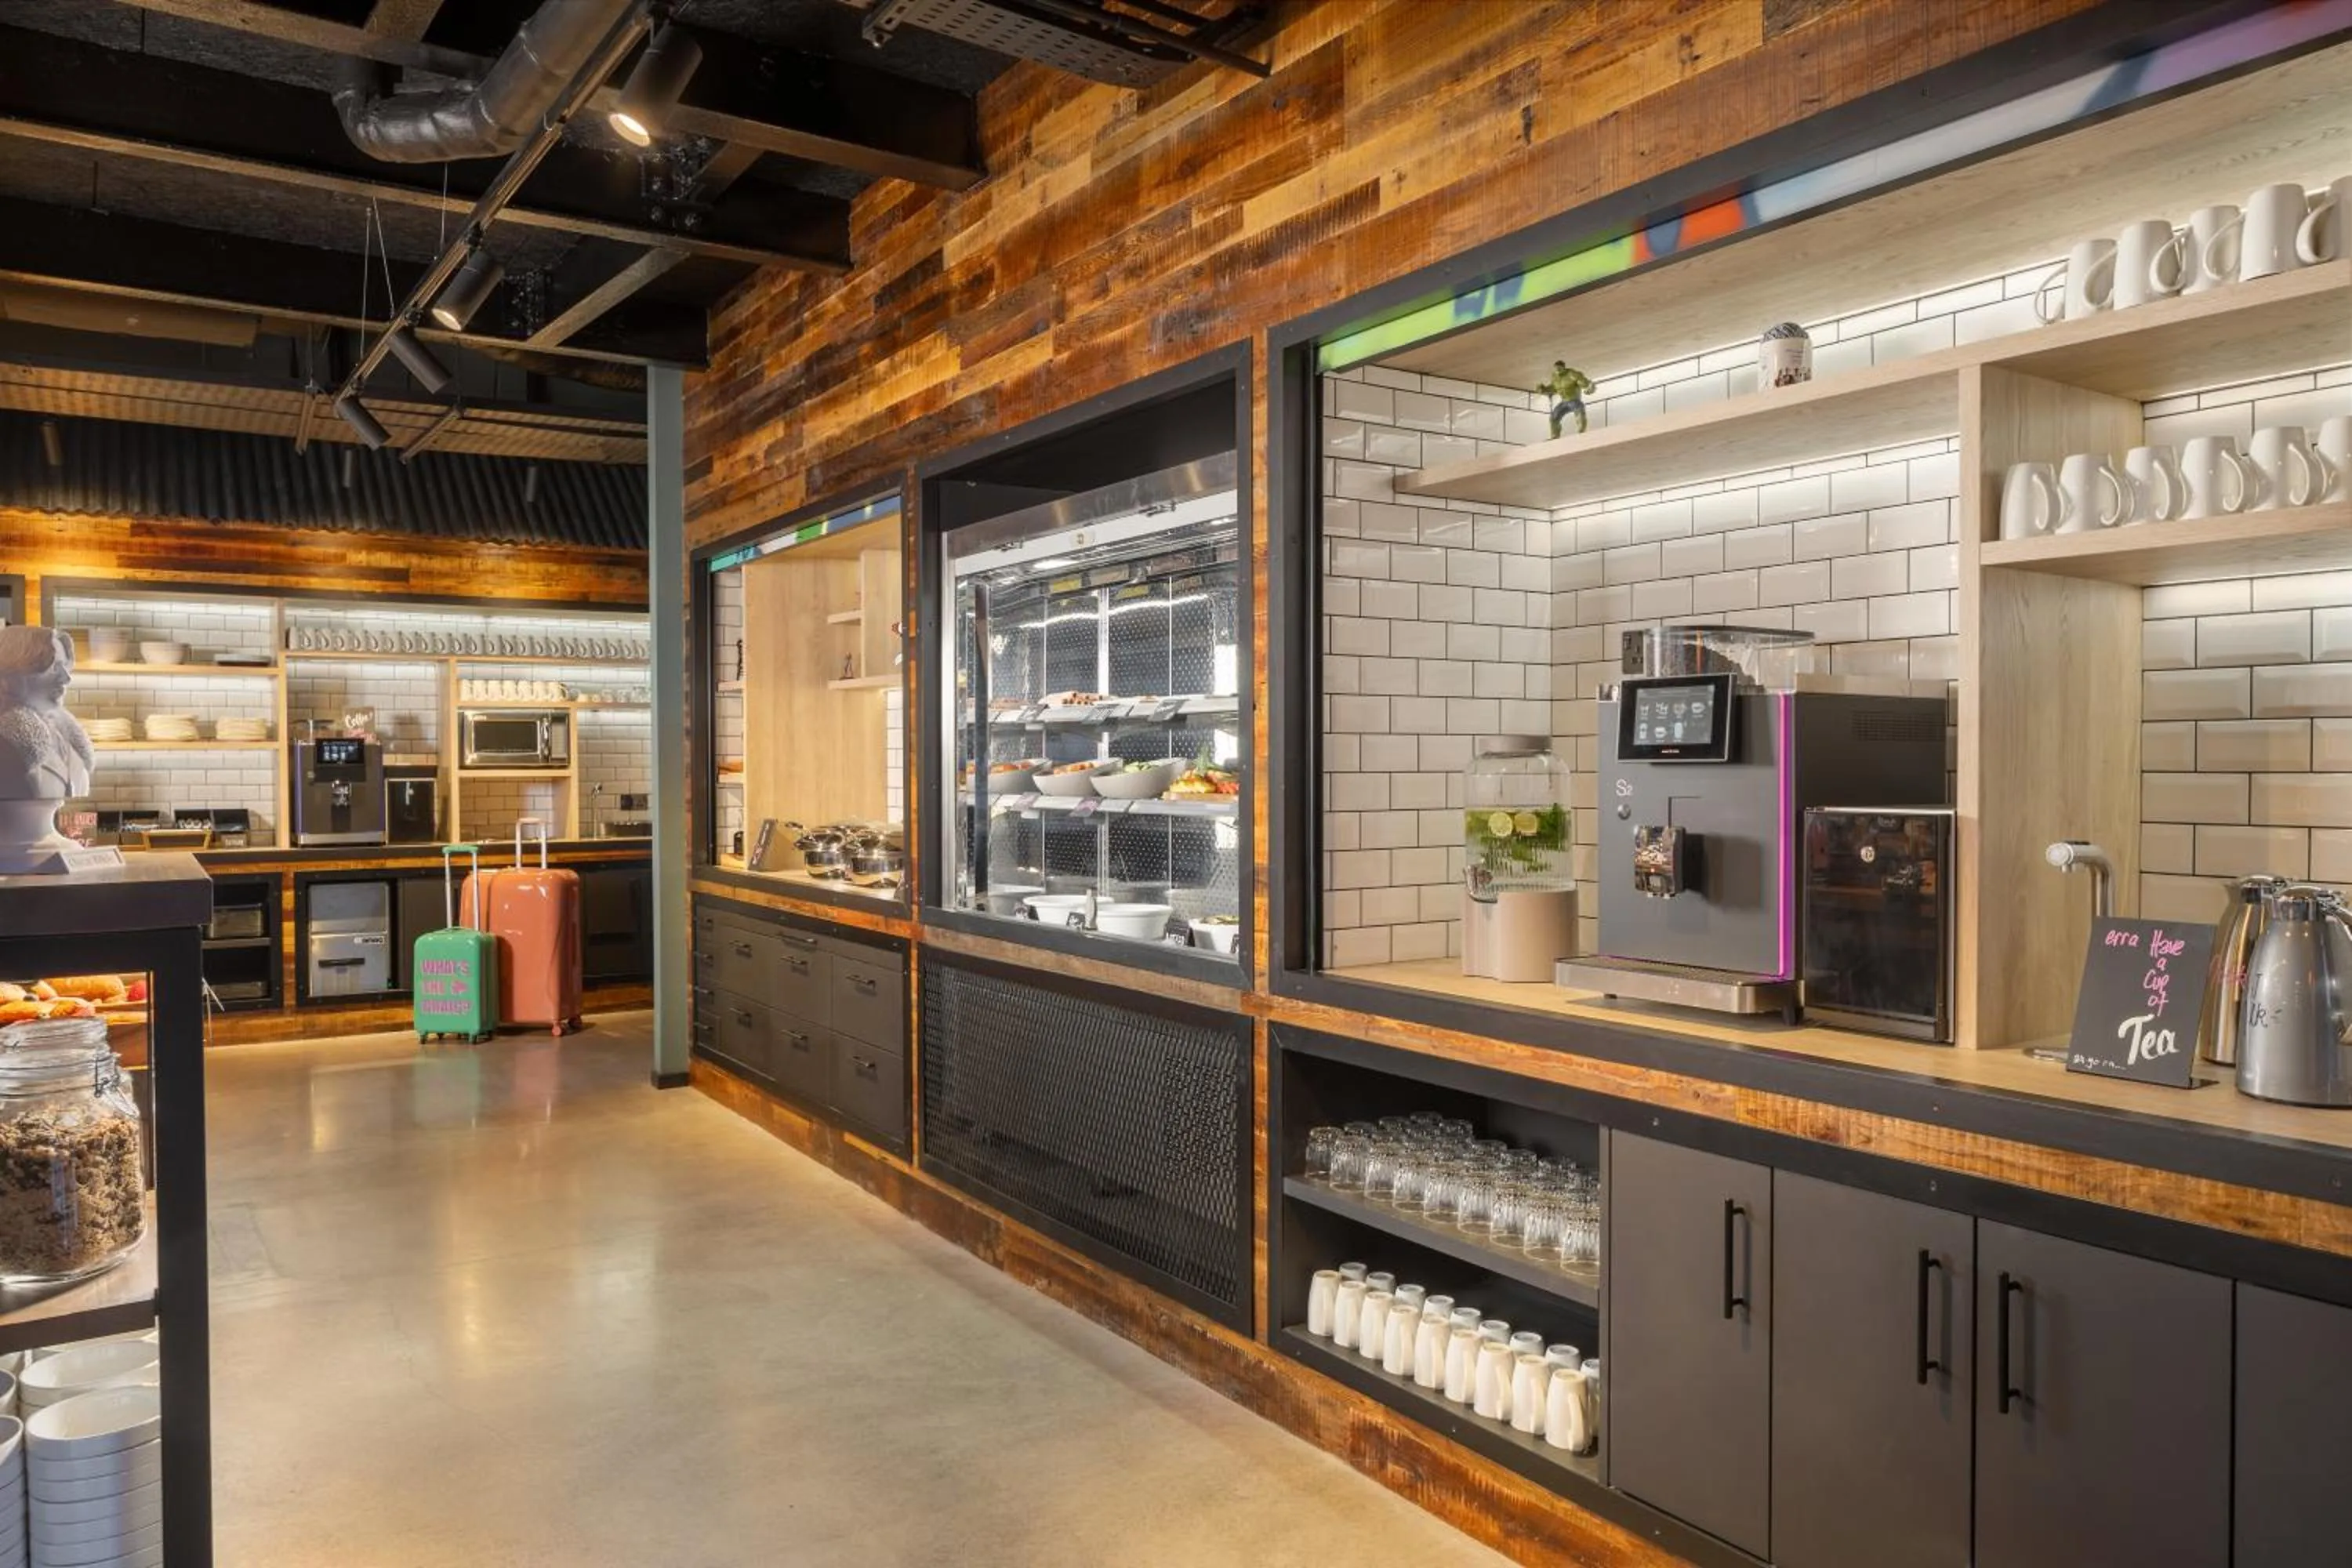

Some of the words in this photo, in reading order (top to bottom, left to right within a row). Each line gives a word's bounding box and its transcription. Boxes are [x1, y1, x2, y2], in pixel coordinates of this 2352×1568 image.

[2151, 929, 2185, 957] Have
[2157, 957, 2167, 971] a
[2143, 969, 2169, 994] Cup
[2147, 991, 2169, 1017] of
[2118, 1014, 2180, 1065] Tea
